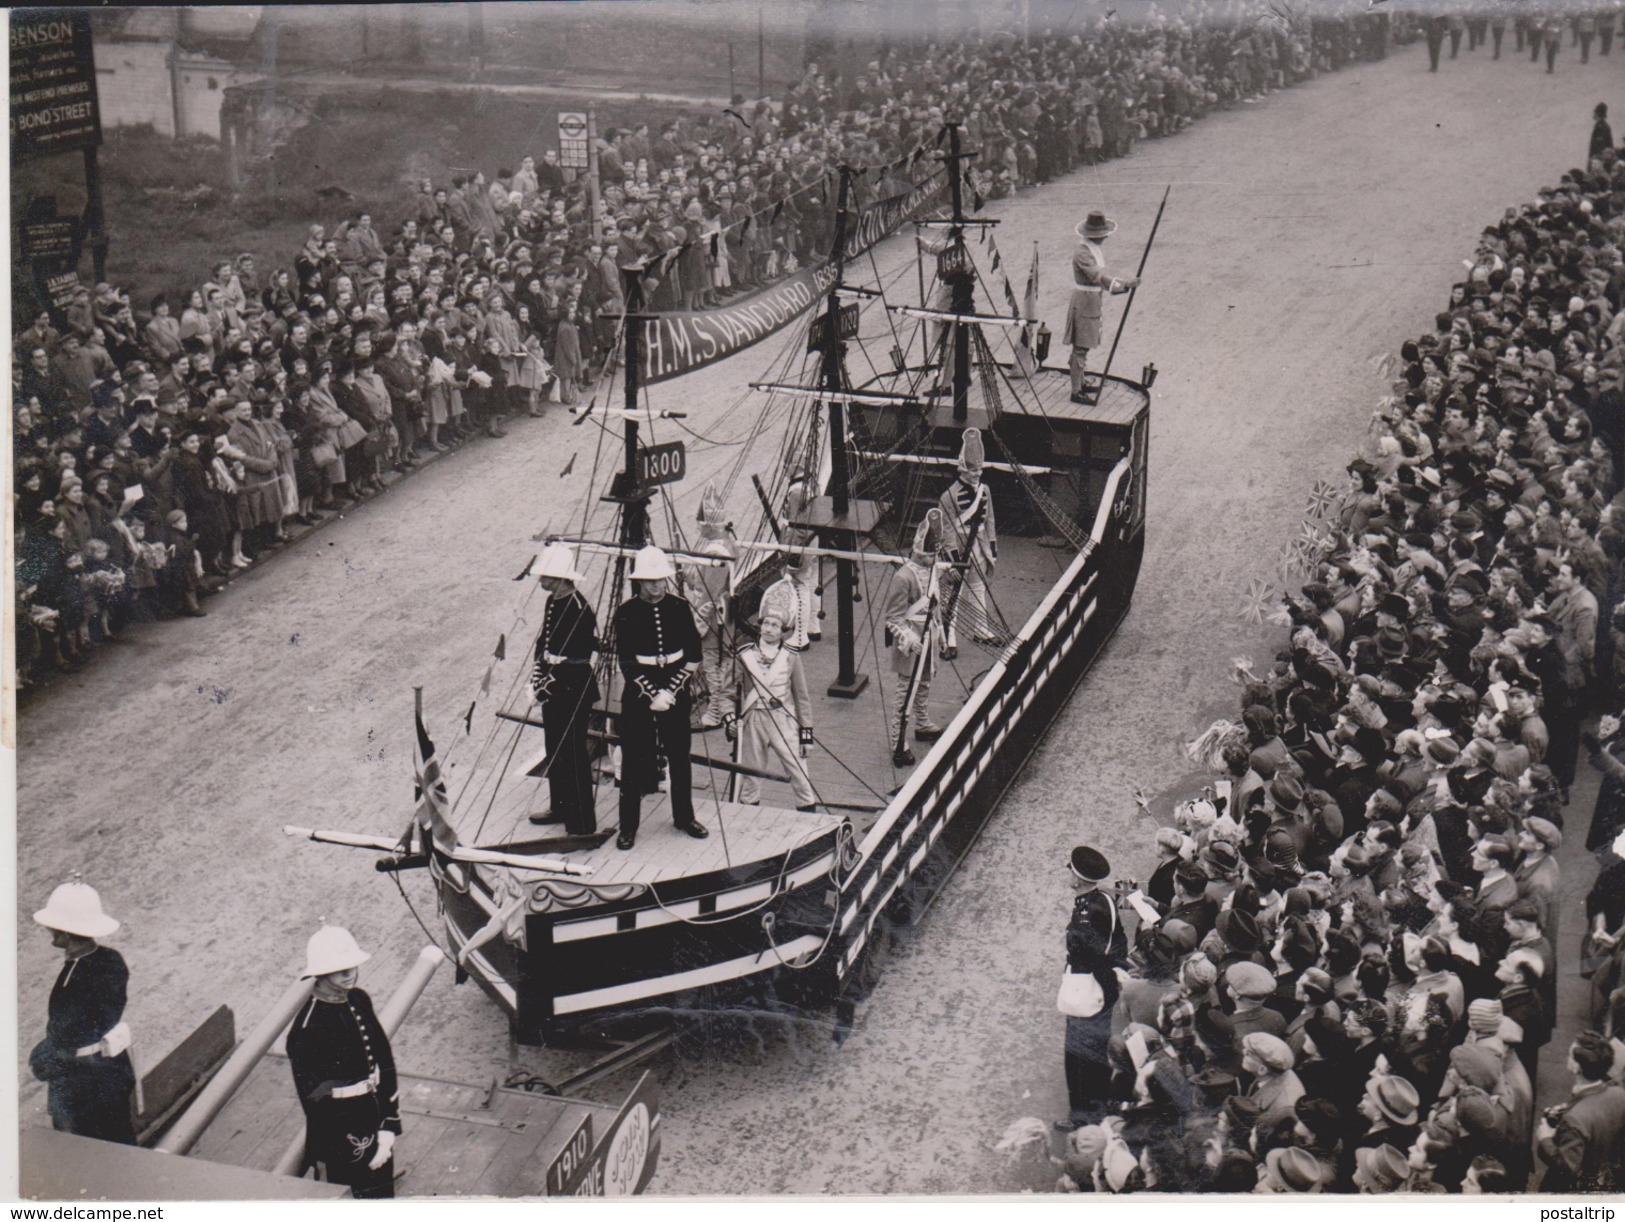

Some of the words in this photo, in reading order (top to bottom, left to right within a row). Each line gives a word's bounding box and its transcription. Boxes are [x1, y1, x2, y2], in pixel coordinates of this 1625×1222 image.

[10, 21, 73, 46] BENSON
[19, 108, 51, 130] BOND
[51, 101, 92, 123] STREET
[942, 251, 963, 273] 1664
[813, 262, 839, 293] 1835
[644, 450, 681, 479] 1800
[557, 1129, 587, 1191] 1910
